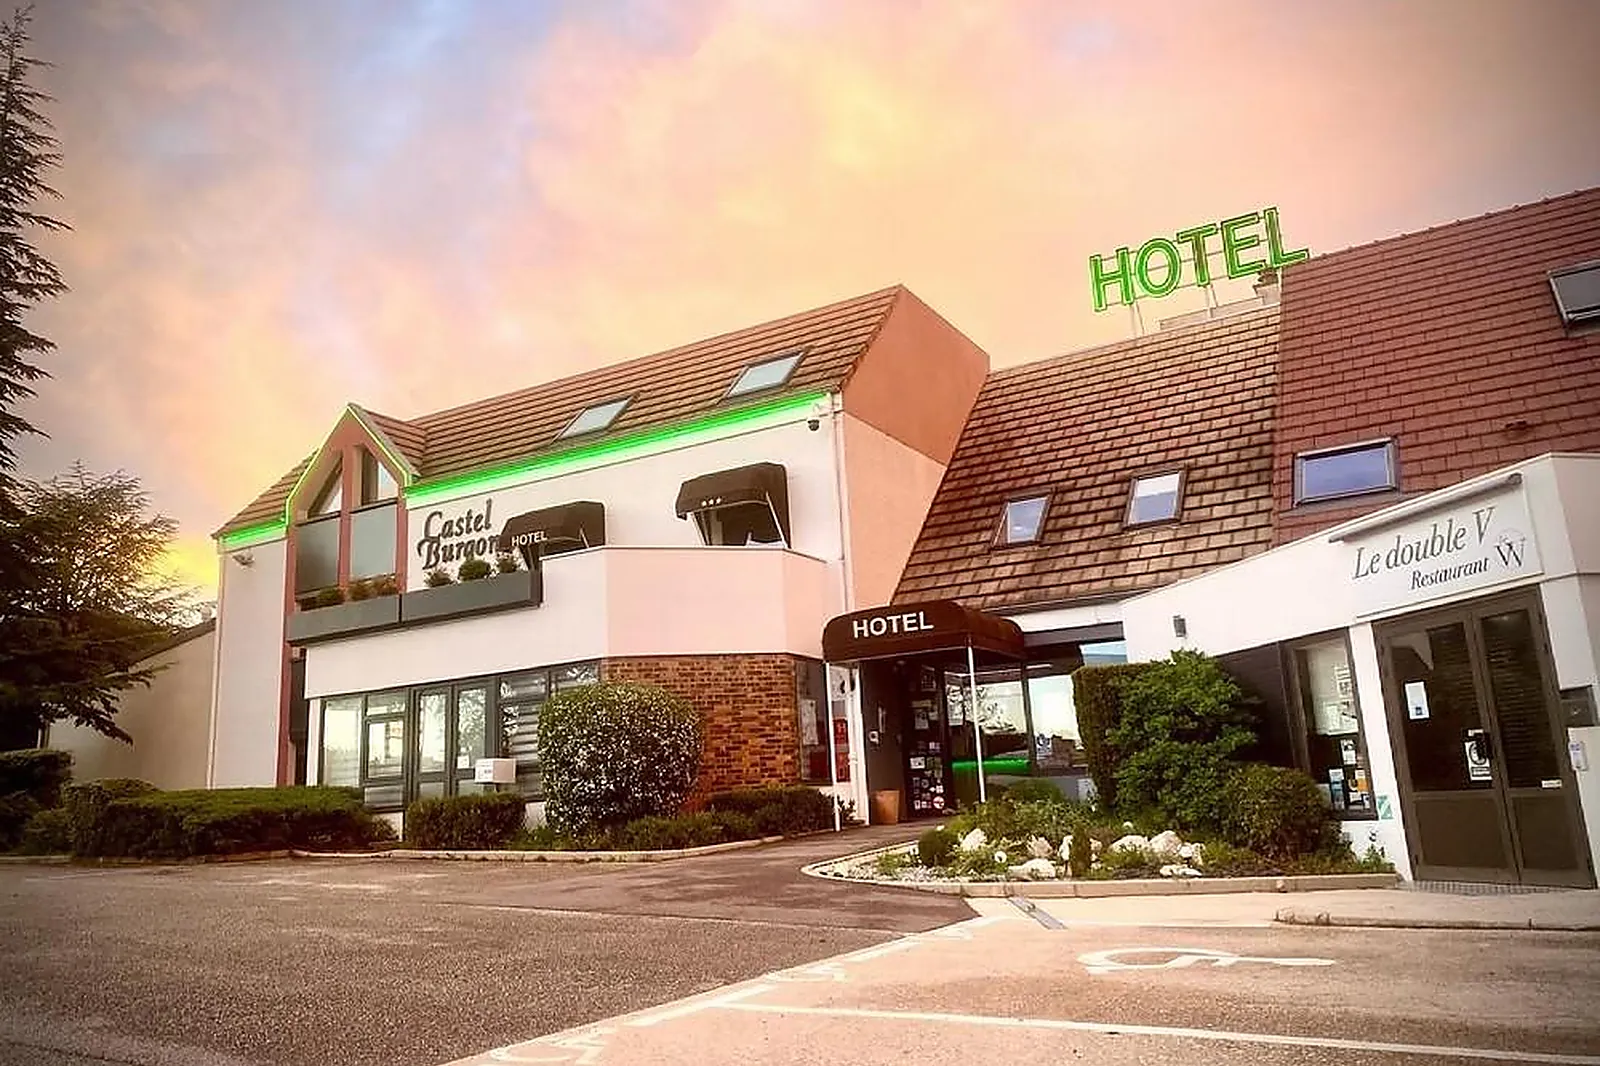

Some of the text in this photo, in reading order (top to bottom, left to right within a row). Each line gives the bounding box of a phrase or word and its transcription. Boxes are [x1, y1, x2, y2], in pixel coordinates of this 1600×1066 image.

[1089, 207, 1310, 312] HOTEL
[424, 498, 492, 538] Castel
[511, 530, 549, 547] HOTEL
[1352, 506, 1496, 580] Le double V
[1410, 557, 1490, 591] Restaurant
[852, 610, 935, 639] HOTEL
